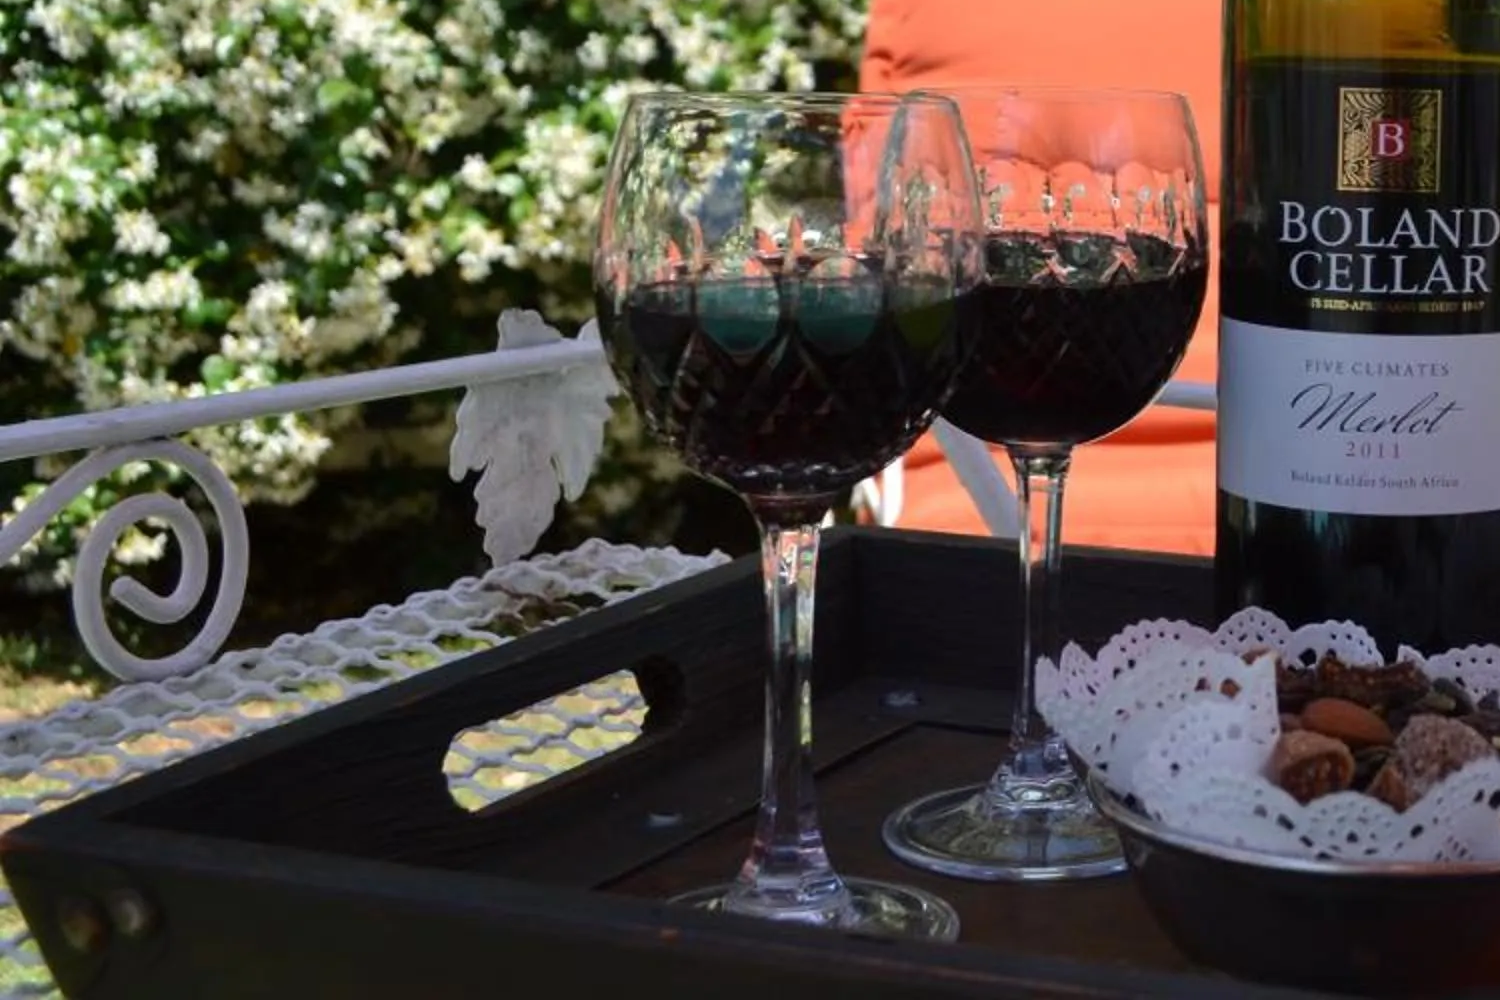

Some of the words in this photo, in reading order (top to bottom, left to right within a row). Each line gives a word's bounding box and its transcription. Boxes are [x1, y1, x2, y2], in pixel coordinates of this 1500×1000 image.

[1378, 123, 1405, 157] B
[1279, 201, 1500, 249] BOLAND
[1290, 251, 1492, 295] CELLAR
[1304, 359, 1344, 376] FIVE
[1351, 361, 1450, 377] CLIMATES
[1290, 383, 1465, 436] Merlot
[1345, 441, 1401, 460] 2011
